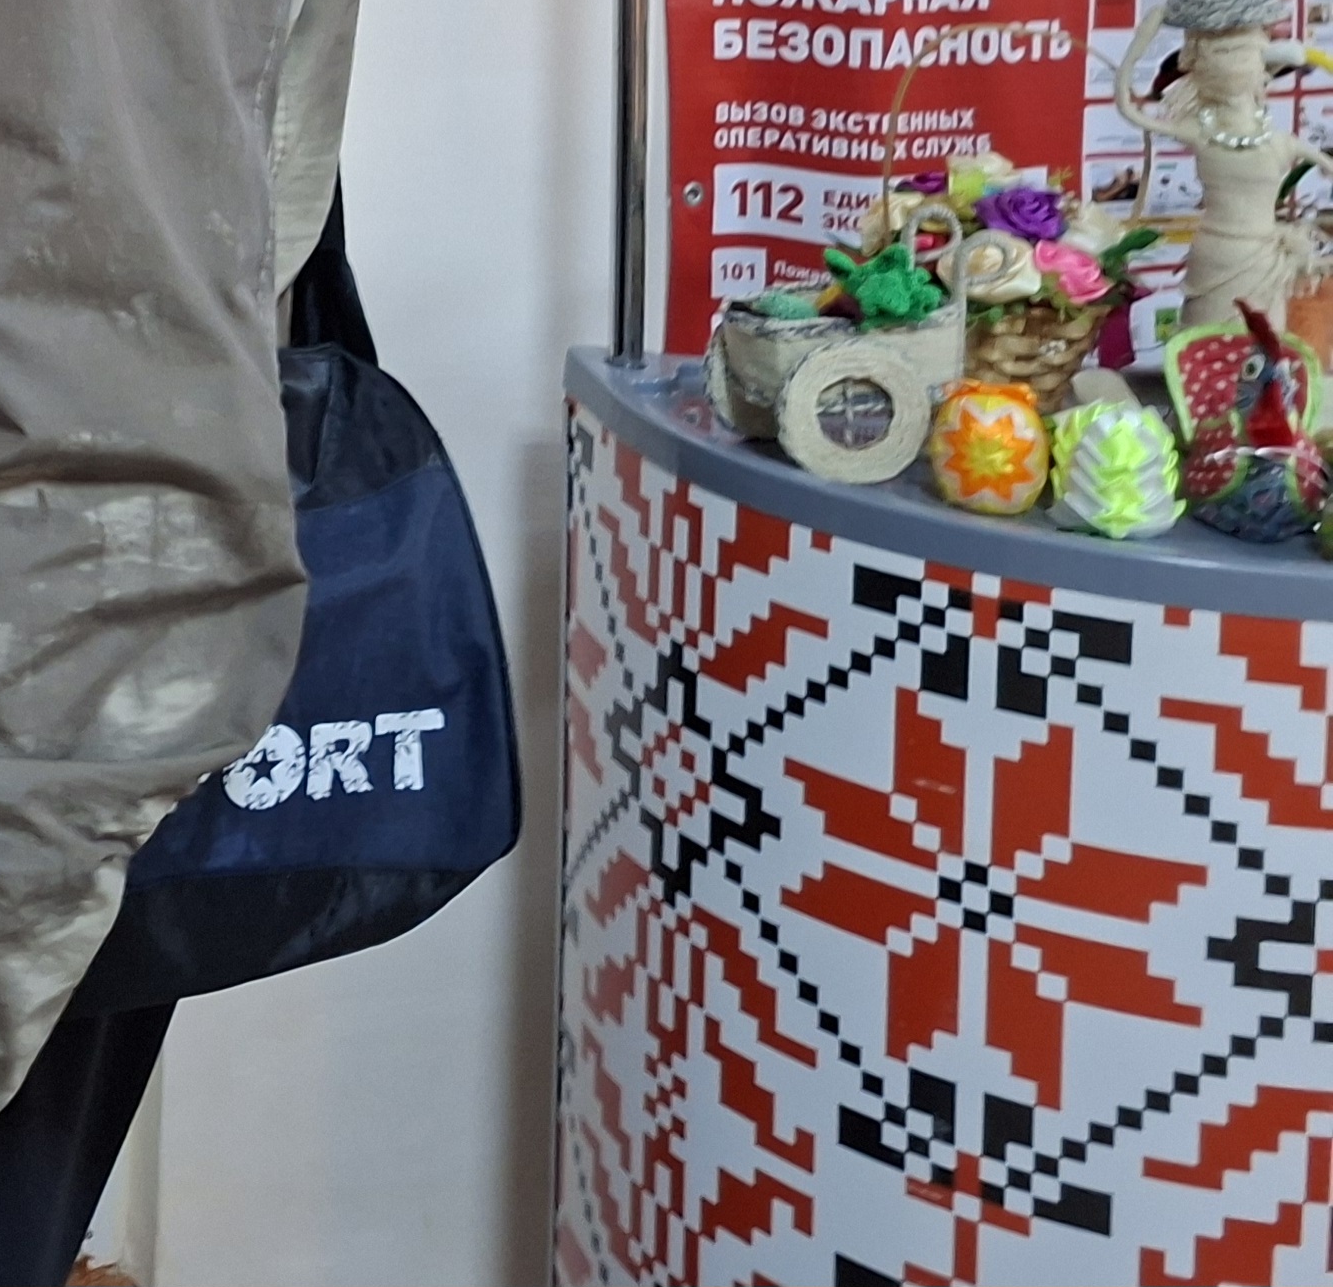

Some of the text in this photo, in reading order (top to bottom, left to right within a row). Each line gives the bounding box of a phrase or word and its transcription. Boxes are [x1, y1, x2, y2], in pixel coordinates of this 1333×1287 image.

[714, 17, 1072, 70] БЕЗОПАСНОСТЬ
[715, 100, 805, 127] ВЫЗОВ
[911, 133, 992, 158] СЛУЖБ
[731, 179, 804, 225] 112
[720, 262, 757, 282] 101
[197, 708, 445, 810] ORT
